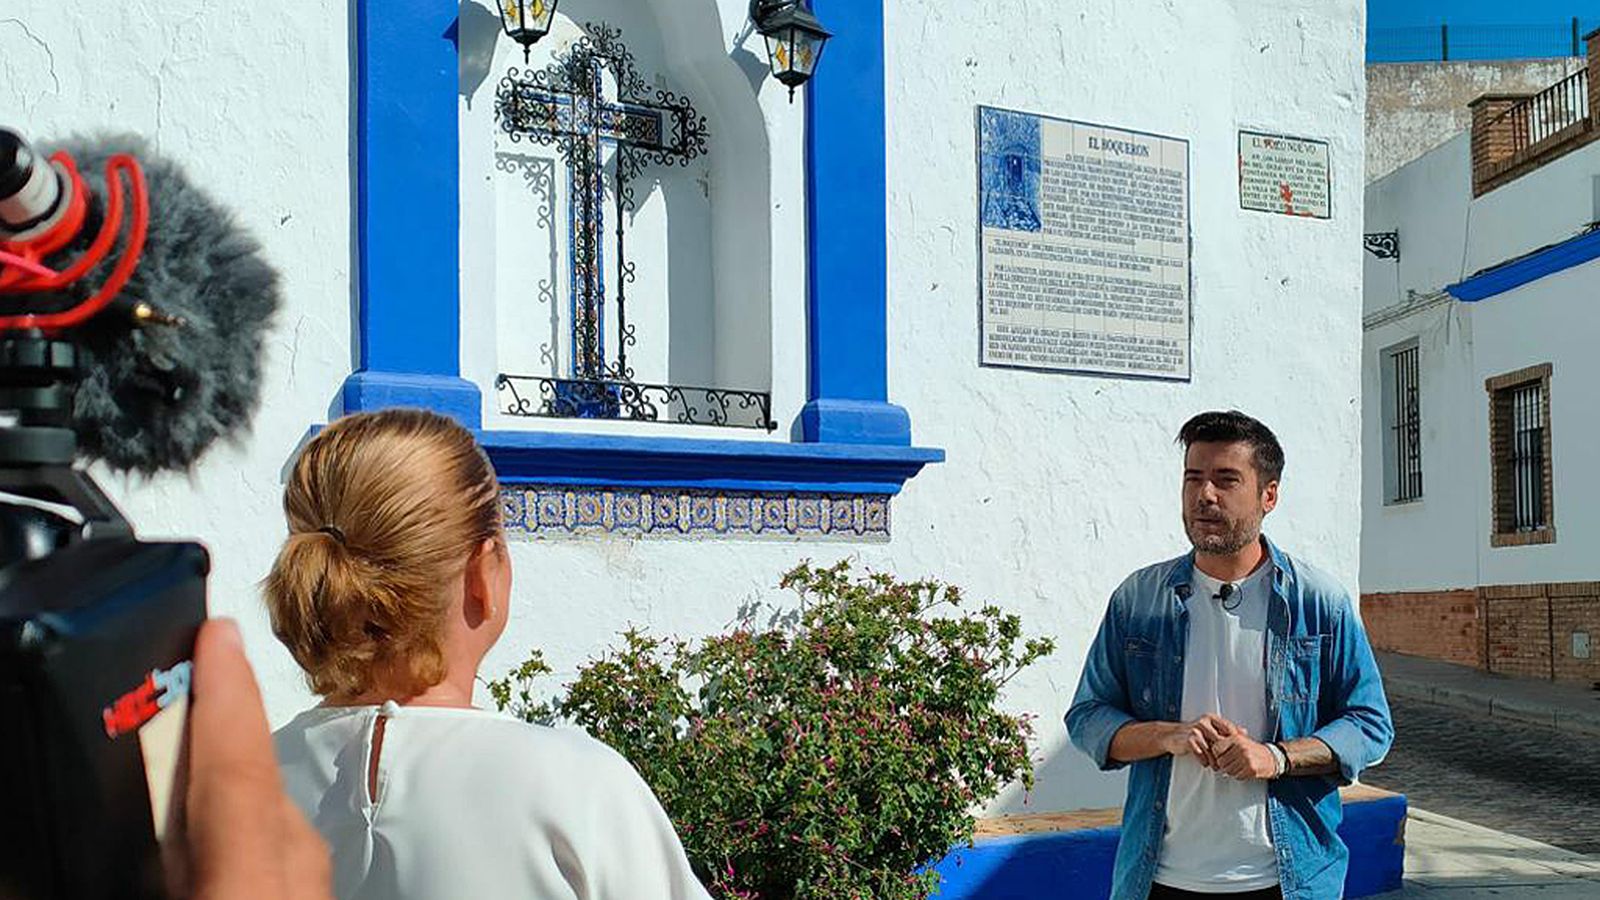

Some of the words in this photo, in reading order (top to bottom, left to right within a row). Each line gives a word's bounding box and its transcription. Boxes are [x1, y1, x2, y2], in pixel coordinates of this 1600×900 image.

[1089, 137, 1099, 150] EL
[1252, 137, 1262, 147] EL
[1287, 142, 1316, 154] NUEVO
